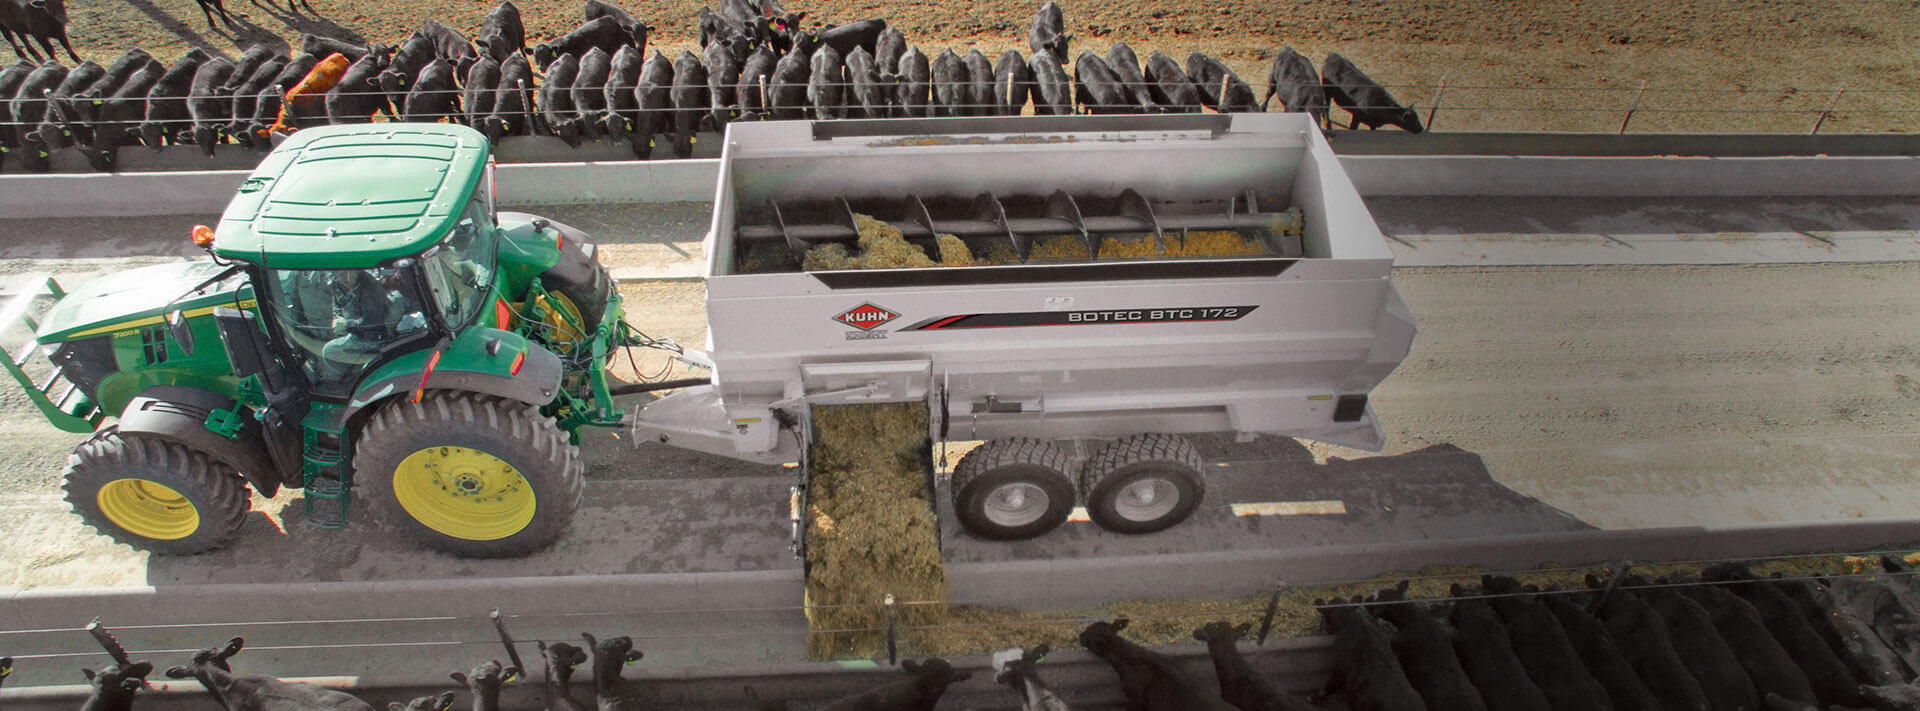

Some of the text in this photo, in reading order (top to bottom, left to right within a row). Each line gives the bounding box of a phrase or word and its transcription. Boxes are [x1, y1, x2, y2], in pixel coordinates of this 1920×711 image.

[845, 312, 889, 322] KUHN
[1068, 308, 1238, 322] BOTEC BTC 172
